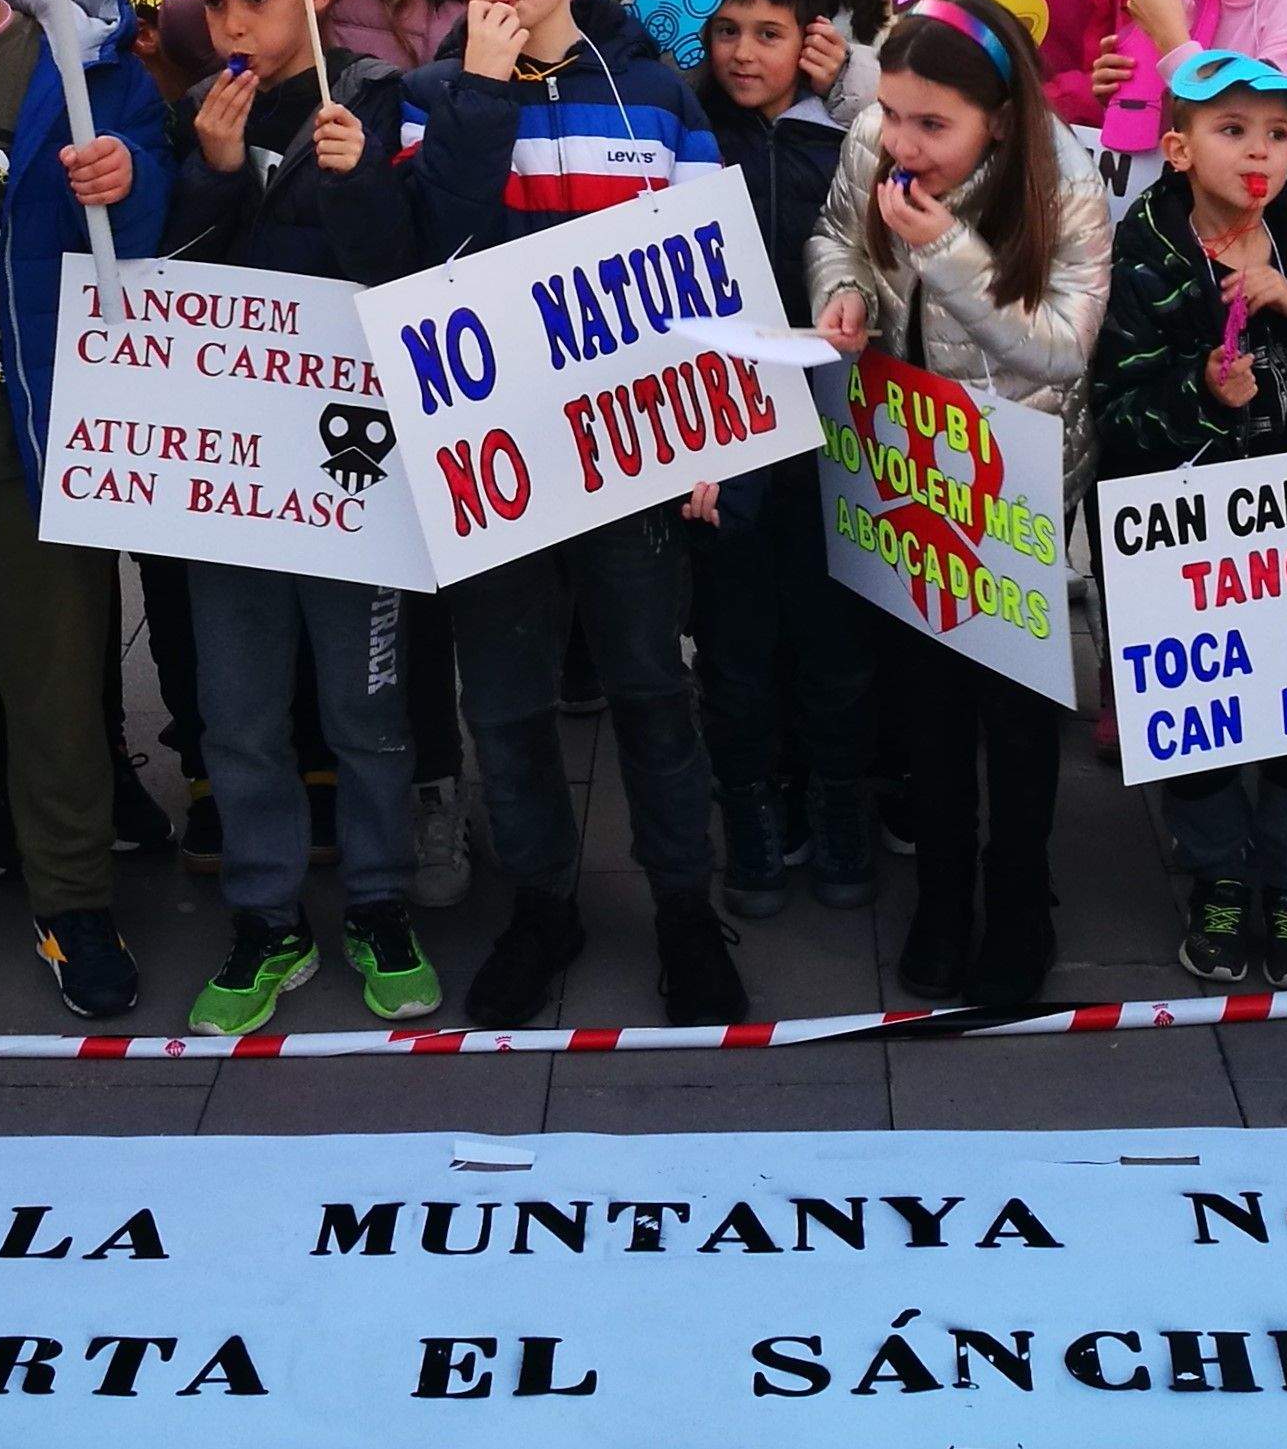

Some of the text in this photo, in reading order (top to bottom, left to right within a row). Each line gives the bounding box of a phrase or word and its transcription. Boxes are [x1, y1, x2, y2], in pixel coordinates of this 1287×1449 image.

[77, 329, 174, 370] CAN
[401, 220, 743, 416] NO NATURE
[65, 417, 263, 469] ATUREM
[436, 349, 778, 537] NO FUTURE
[847, 362, 996, 464] A RUBÍ
[61, 465, 366, 533] CAN BALASC
[820, 414, 1058, 567] NO VOLEM MÉS
[1113, 494, 1208, 557] CAN
[837, 495, 1051, 640] ABOCADORS
[368, 585, 402, 695] TRACK
[1123, 630, 1253, 694] TOCA
[1146, 697, 1244, 761] CAN
[311, 1195, 1065, 1257] MUNTANYA
[410, 1335, 598, 1399] EL
